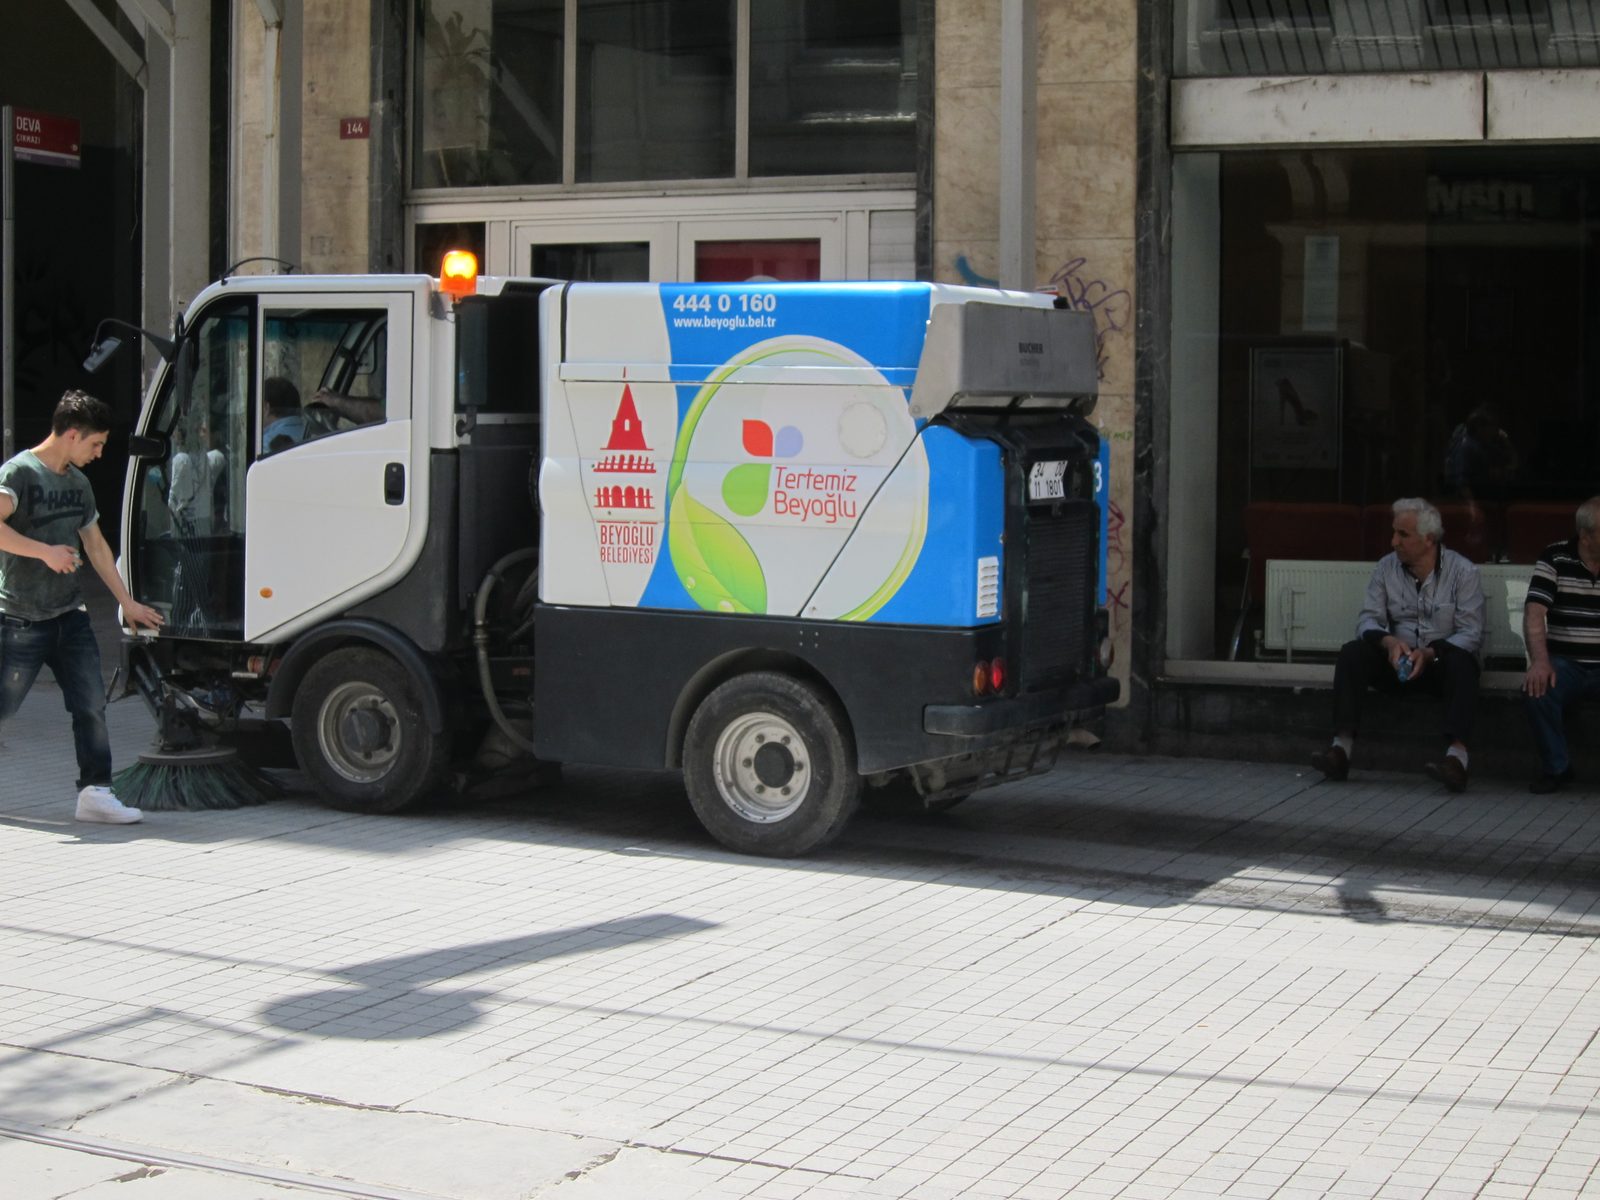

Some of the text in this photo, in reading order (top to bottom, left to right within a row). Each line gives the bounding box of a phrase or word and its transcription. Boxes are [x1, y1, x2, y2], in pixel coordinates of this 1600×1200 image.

[16, 116, 41, 133] DEVA
[347, 123, 363, 135] 144
[673, 293, 776, 312] 444 0 160
[673, 315, 776, 331] www.beyoglu.bel.tr
[1018, 342, 1044, 354] BUCHER
[1034, 462, 1046, 478] 34
[775, 466, 857, 492] Tertemiz
[1034, 481, 1041, 497] 11
[774, 490, 857, 523] Beyoğlu
[600, 521, 654, 546] BEYOĞLU
